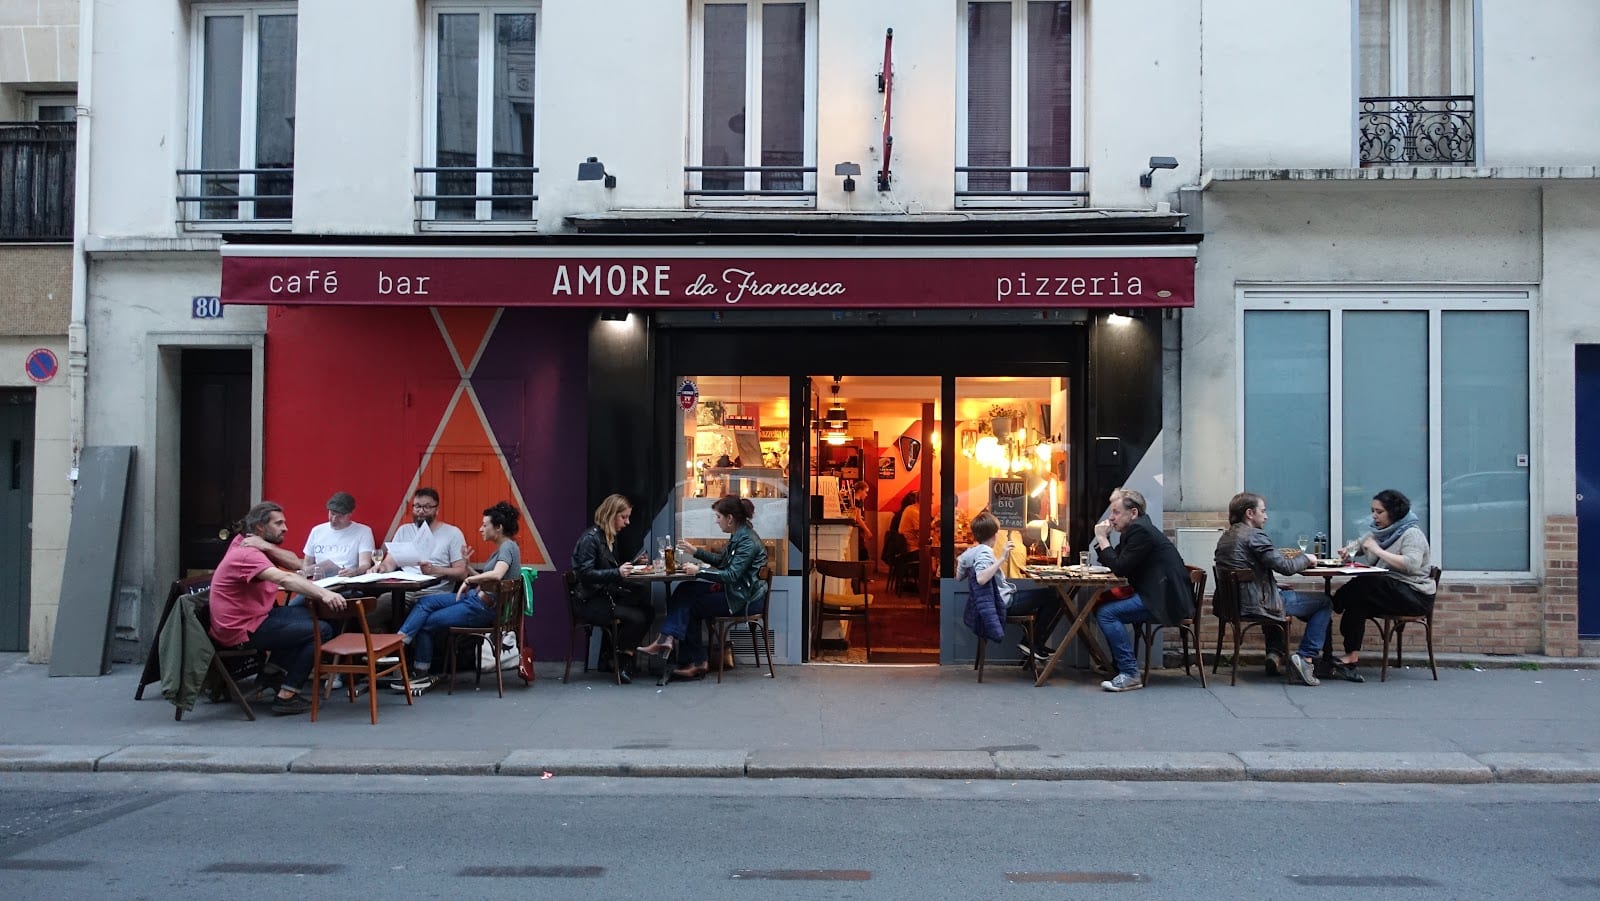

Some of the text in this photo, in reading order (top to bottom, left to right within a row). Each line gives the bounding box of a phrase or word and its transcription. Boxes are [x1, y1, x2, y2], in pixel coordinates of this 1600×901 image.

[269, 270, 431, 295] café bar
[552, 264, 846, 304] AMORE da Francesca
[997, 271, 1142, 301] pizzeria
[196, 297, 220, 317] 80
[998, 500, 1015, 508] BIO
